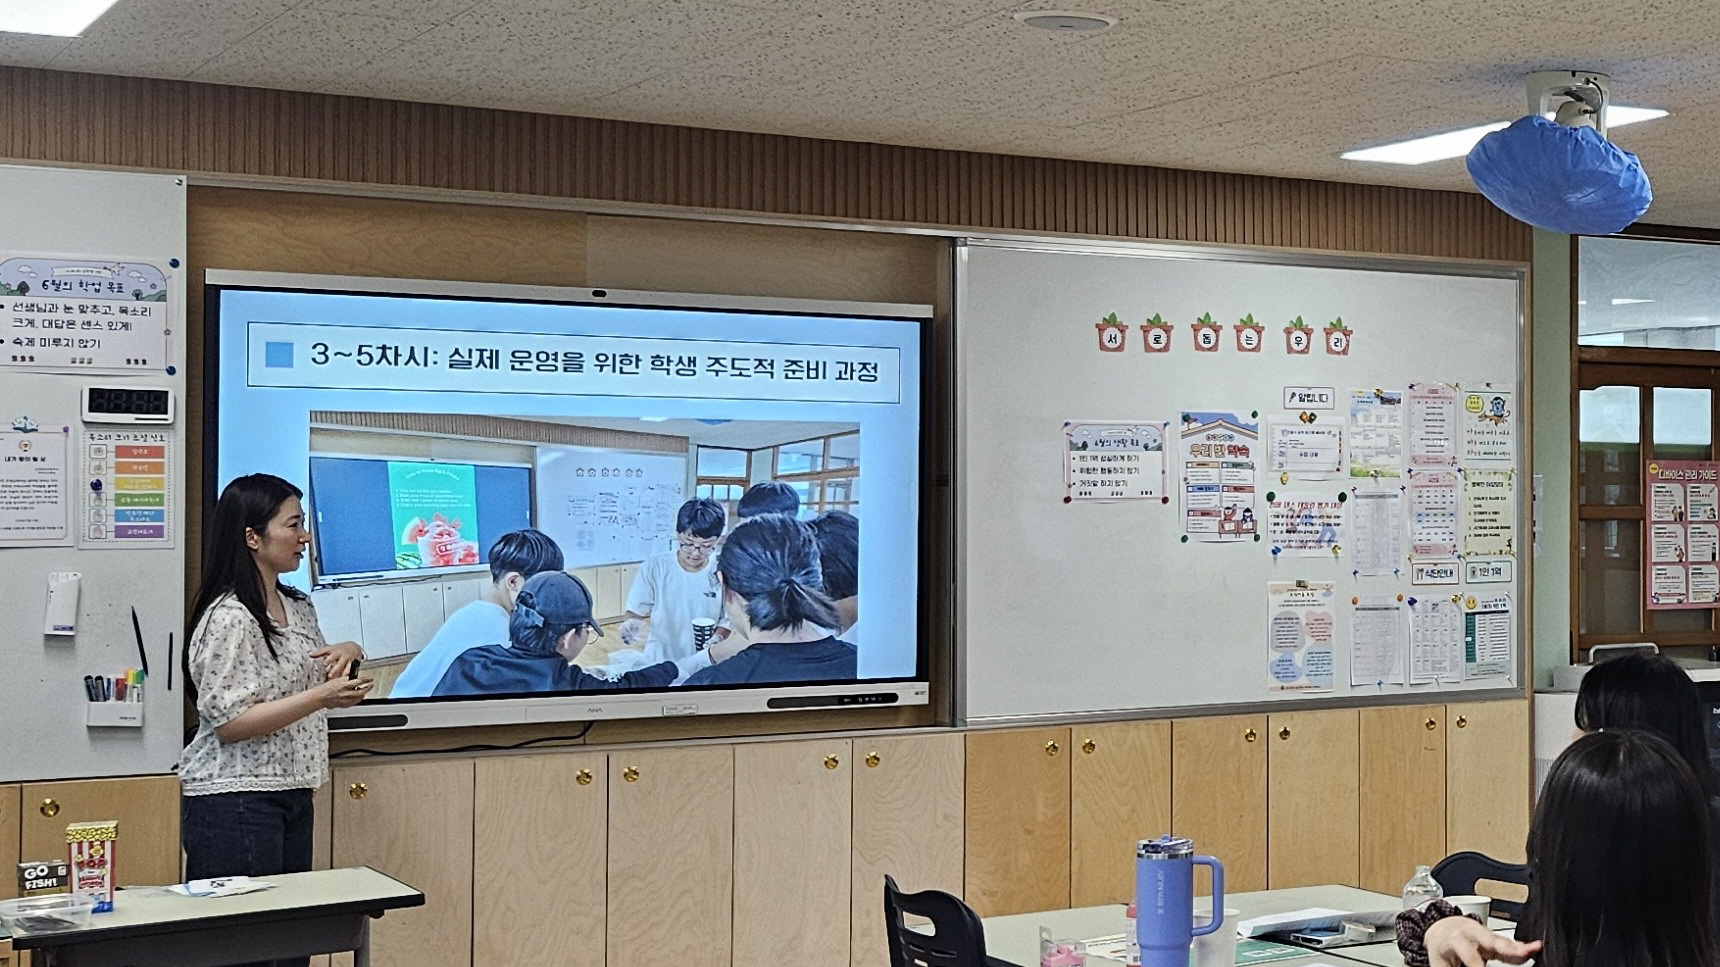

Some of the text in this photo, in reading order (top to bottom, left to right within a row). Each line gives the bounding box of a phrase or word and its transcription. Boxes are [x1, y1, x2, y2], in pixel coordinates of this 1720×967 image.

[42, 279, 72, 291] 6월의
[78, 279, 101, 293] 학업
[13, 302, 151, 317] 선생님과 눈 맞추고, 목소리
[42, 319, 77, 329] 대답은
[81, 320, 103, 330] 센스
[13, 338, 100, 349] 숙제 미루지 않기
[310, 342, 878, 383] 3~5차시: 실제 운영을 위한 학생 주도적 준비 과정
[1298, 393, 1329, 403] 알립니다
[1190, 444, 1212, 458] 우리
[1214, 444, 1226, 458] 반
[1659, 470, 1718, 480] 디바이스 관리 가이드
[1425, 568, 1453, 578] 식단안내
[24, 865, 48, 879] GO
[25, 878, 58, 890] FISH!
